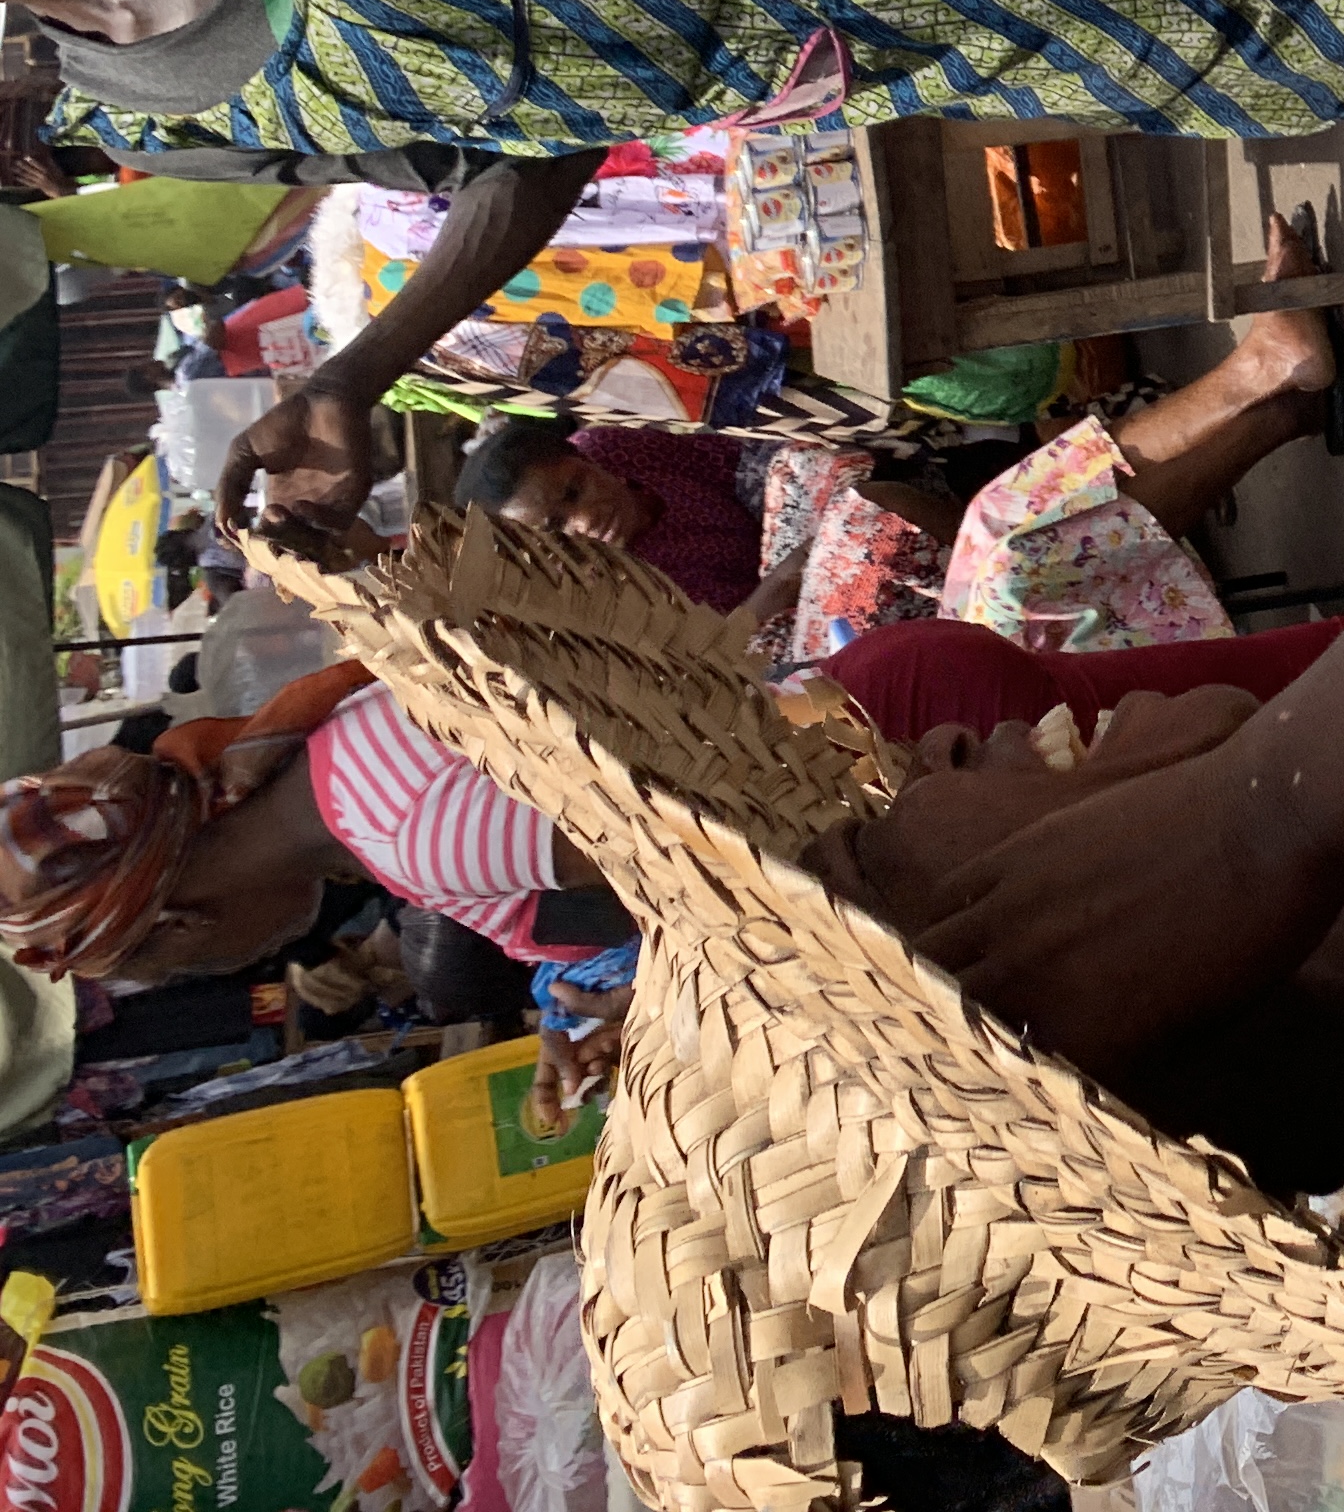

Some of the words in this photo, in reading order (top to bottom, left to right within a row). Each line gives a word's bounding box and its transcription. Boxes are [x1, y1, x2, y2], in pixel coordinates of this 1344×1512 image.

[409, 1322, 431, 1389] Pakistan
[143, 1344, 204, 1449] Grain
[214, 1383, 237, 1435] Rice
[410, 1392, 426, 1409] of
[412, 1410, 443, 1473] Product
[172, 1456, 214, 1512] ong
[216, 1440, 239, 1509] White
